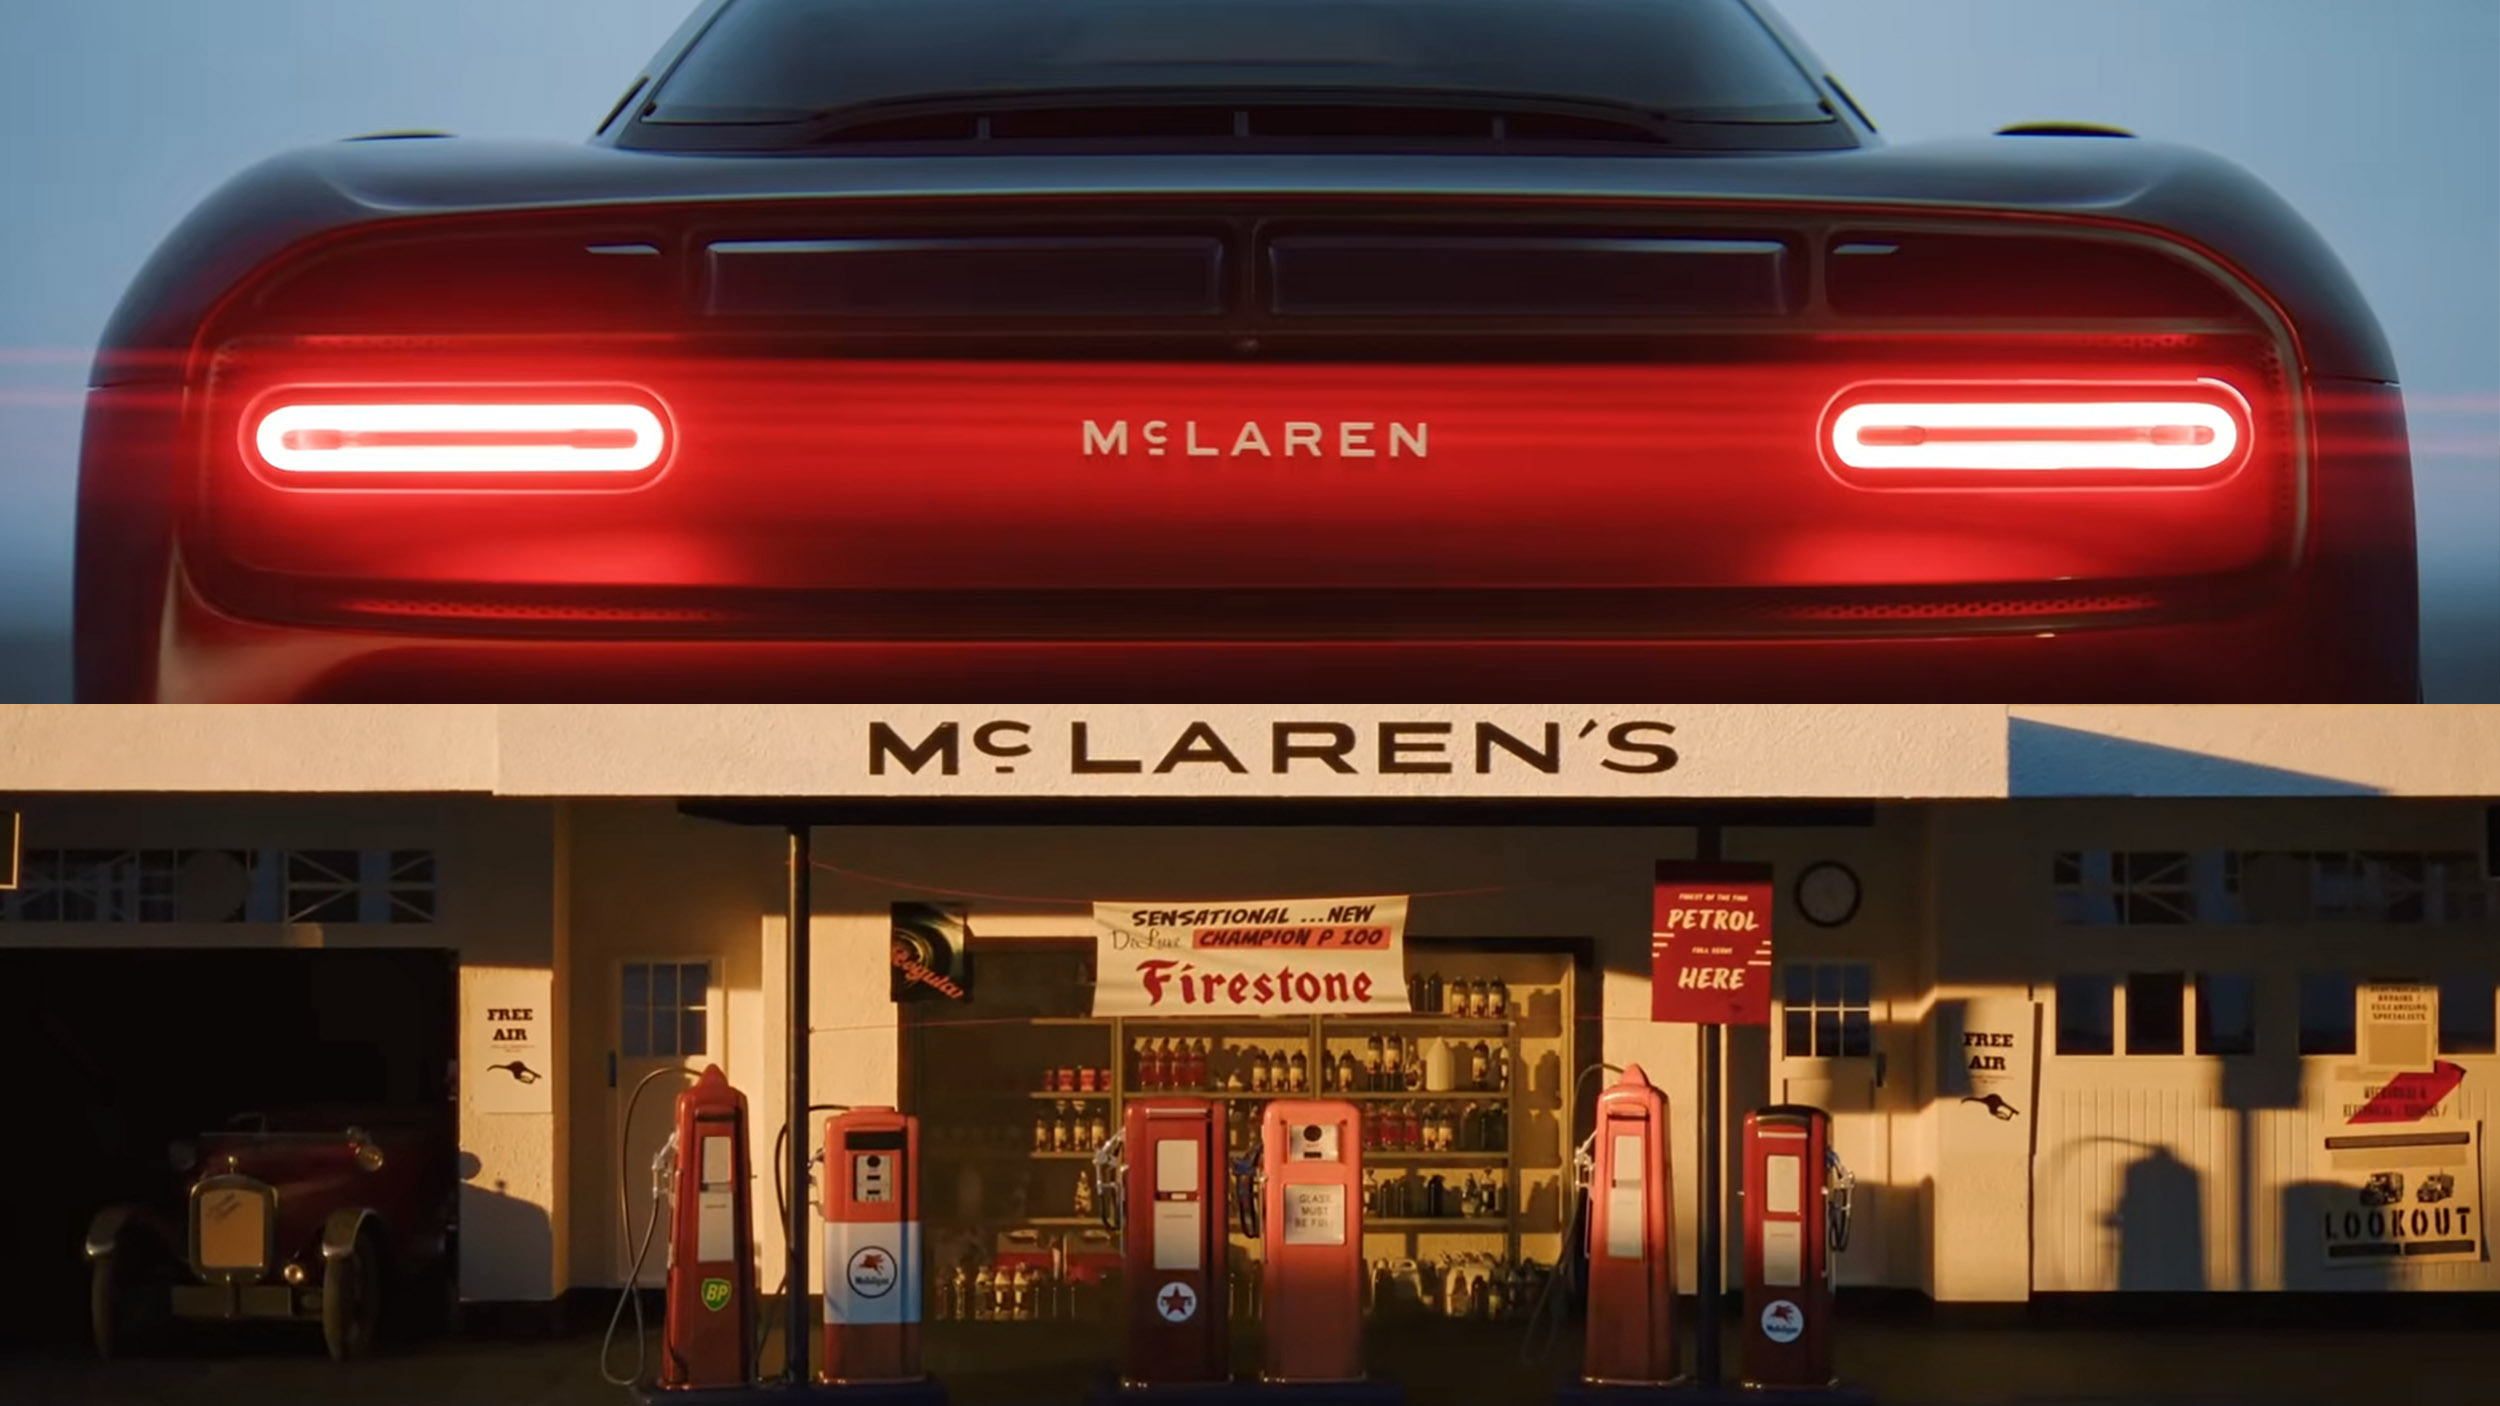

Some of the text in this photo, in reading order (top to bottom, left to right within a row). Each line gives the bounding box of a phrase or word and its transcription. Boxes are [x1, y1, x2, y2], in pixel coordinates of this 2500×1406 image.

[1132, 908, 1290, 926] SENSATIONAL
[1667, 909, 1759, 931] PETROL
[1200, 929, 1311, 947] CHAMPION
[1317, 929, 1333, 945] P
[1341, 928, 1384, 945] 100
[1136, 959, 1373, 1006] Firestone
[1678, 967, 1746, 990] HERE
[487, 1008, 533, 1021] FREE
[493, 1028, 527, 1041] AIR
[1963, 1032, 2014, 1048] FREE
[1968, 1055, 2006, 1071] AIR
[706, 1283, 729, 1301] BP
